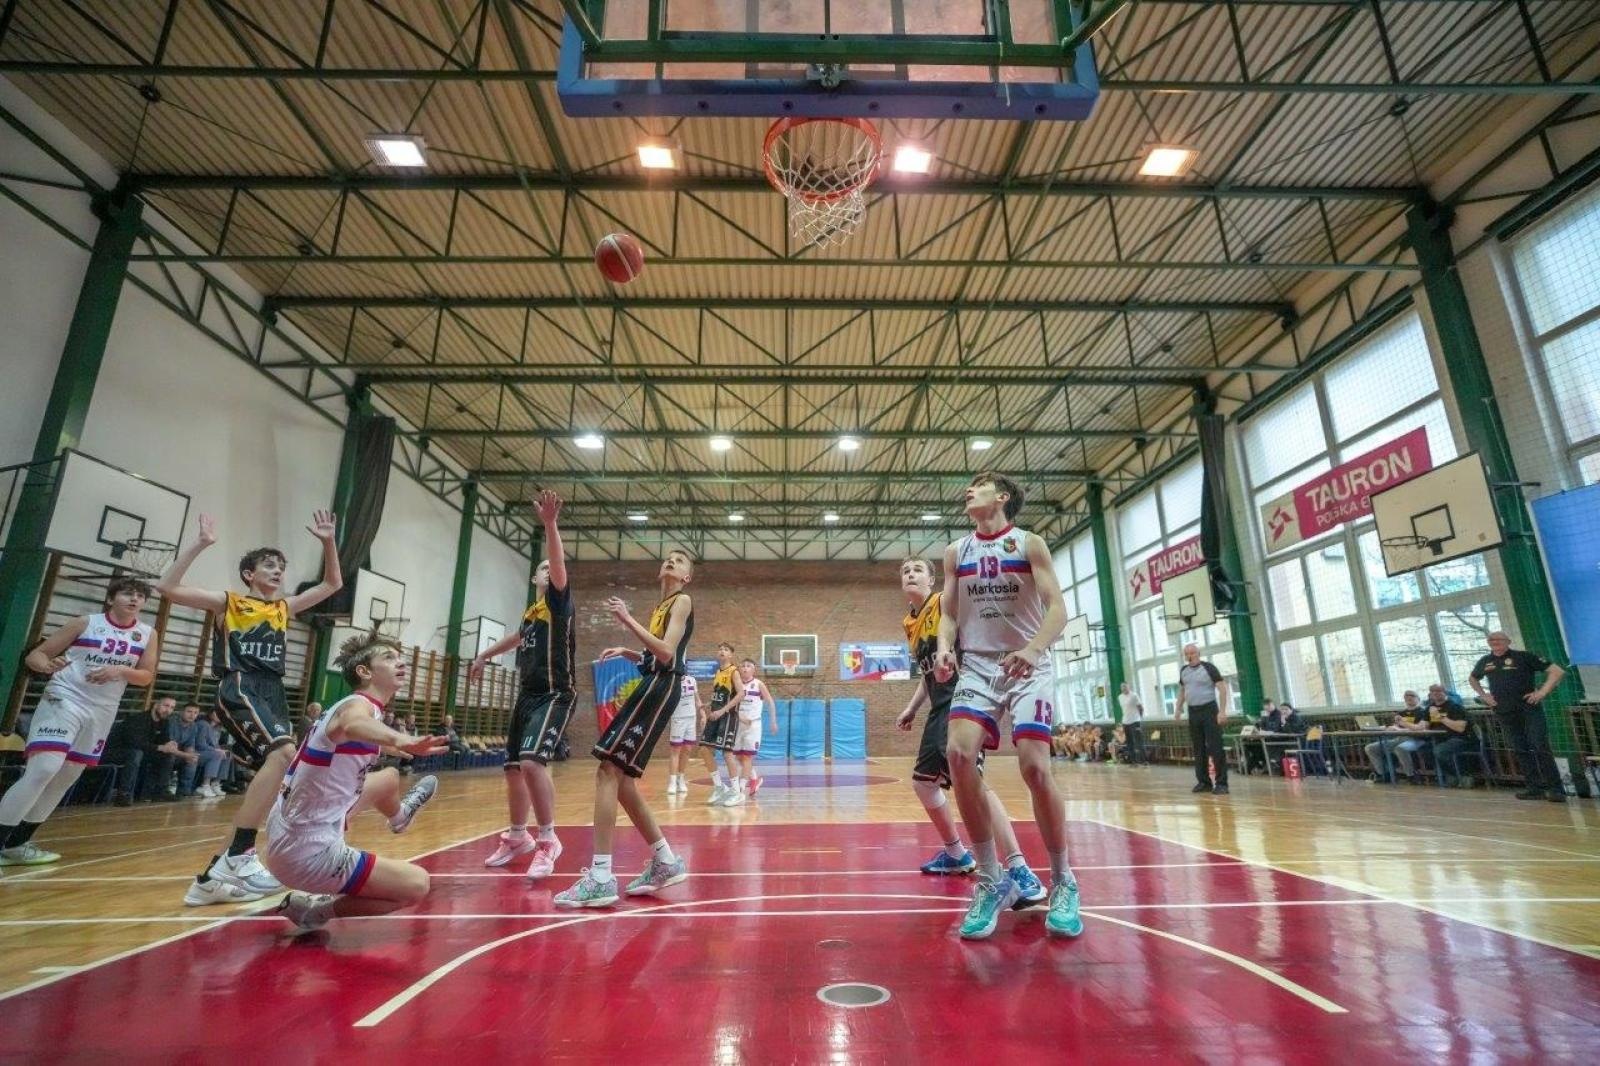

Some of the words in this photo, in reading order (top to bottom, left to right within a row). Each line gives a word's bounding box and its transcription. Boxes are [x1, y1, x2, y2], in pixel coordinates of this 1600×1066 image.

[1305, 446, 1413, 512] TAURON
[980, 556, 999, 579] 13
[1150, 540, 1205, 577] TAURON
[102, 638, 129, 656] 33
[1034, 699, 1052, 726] 13
